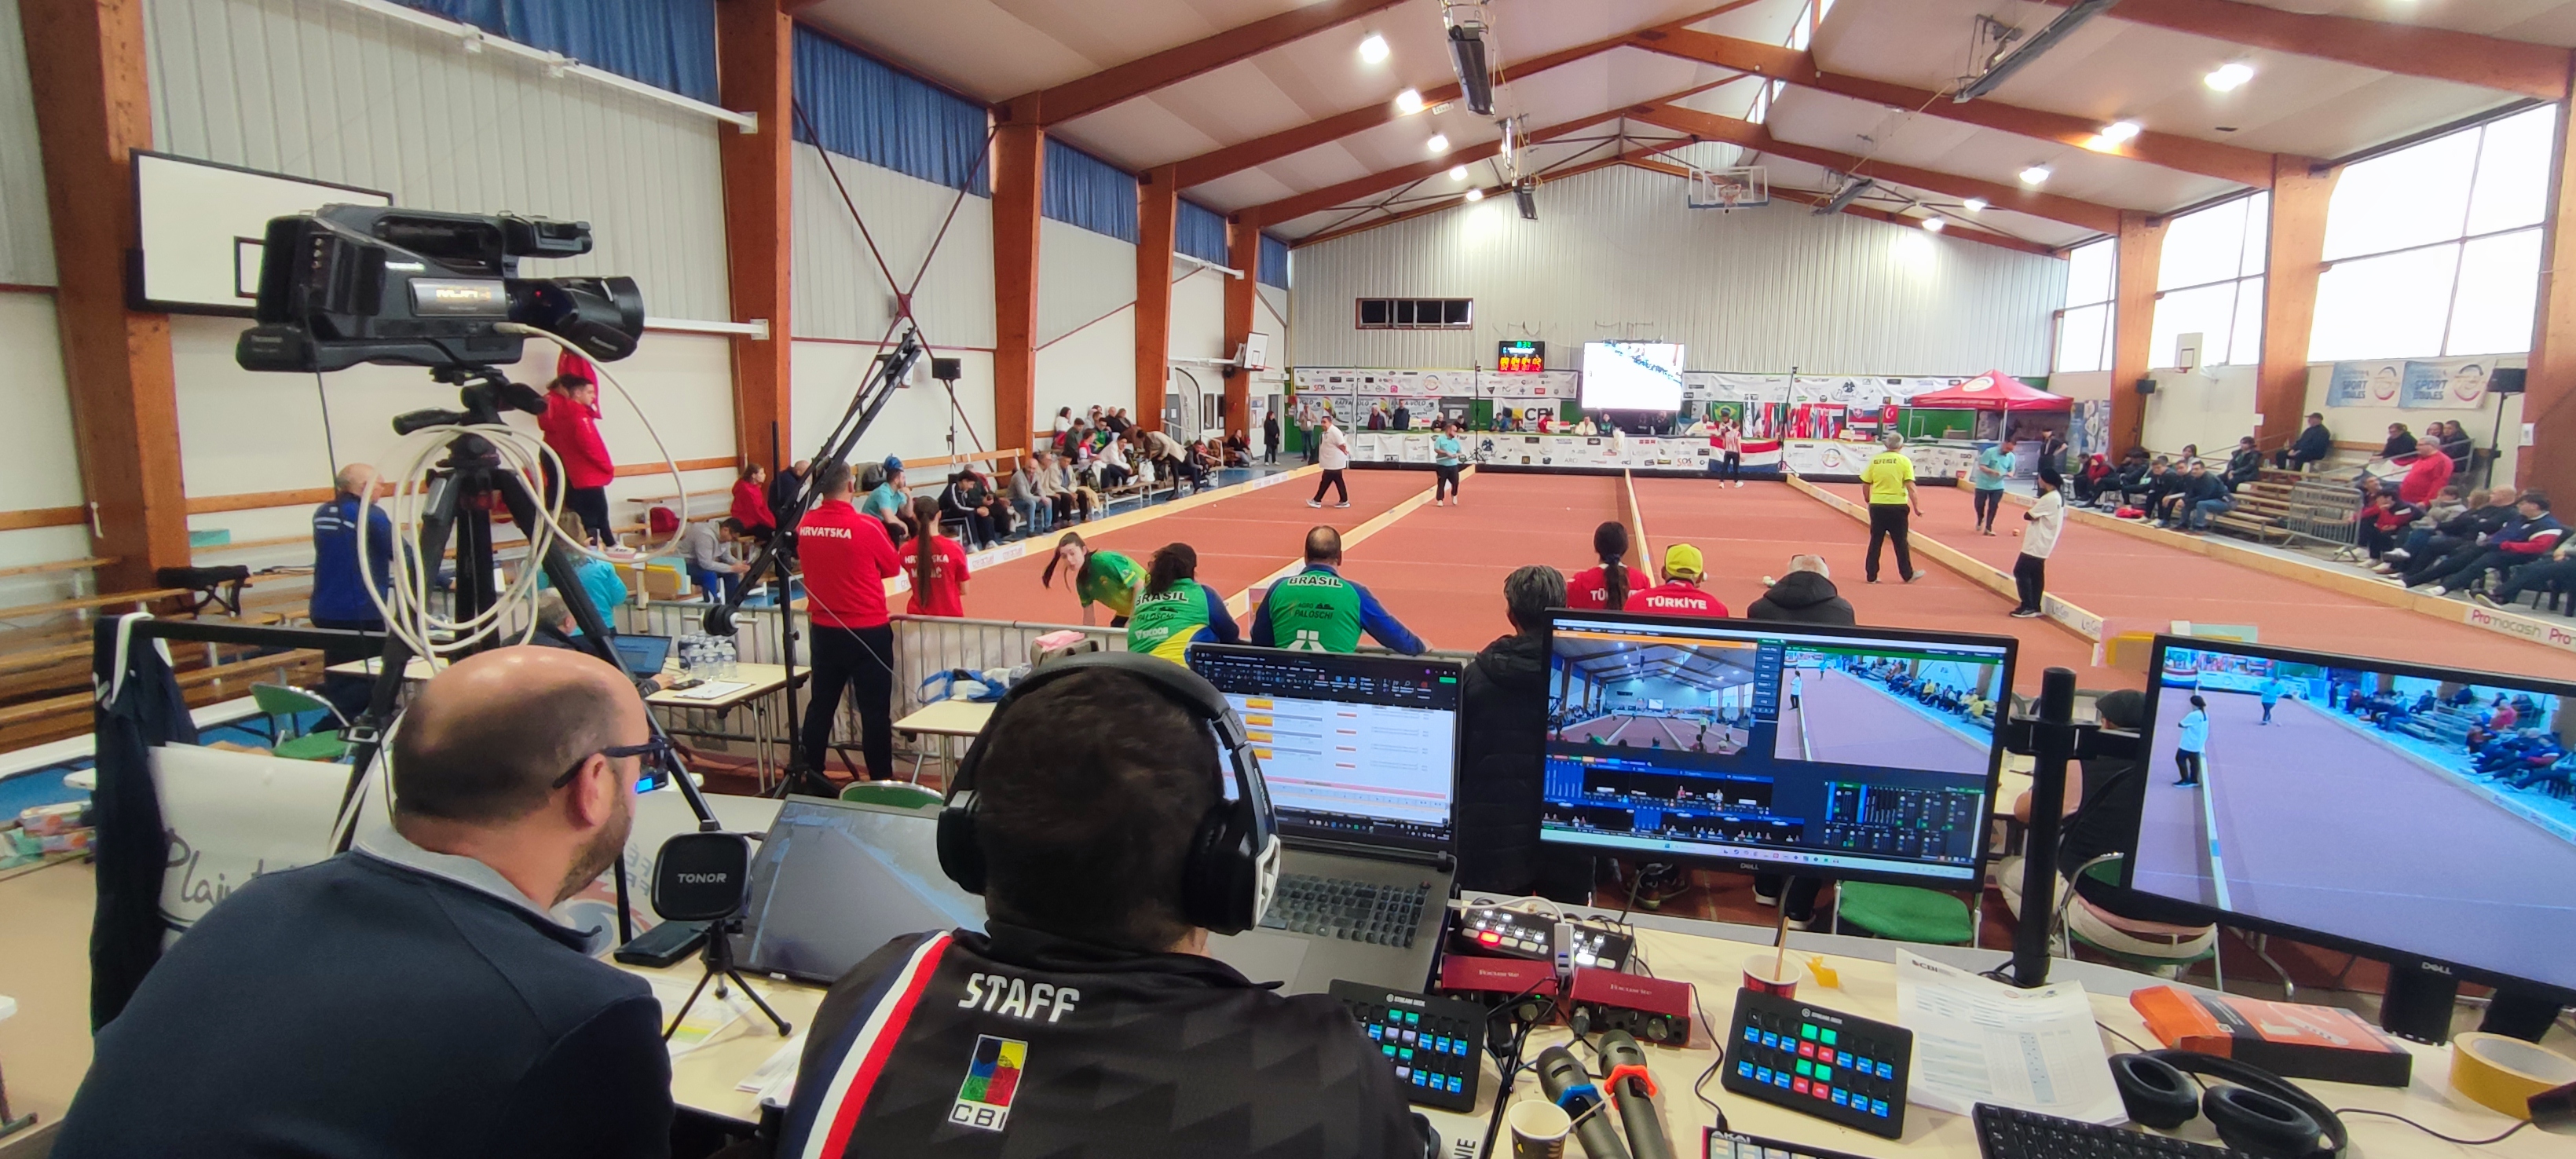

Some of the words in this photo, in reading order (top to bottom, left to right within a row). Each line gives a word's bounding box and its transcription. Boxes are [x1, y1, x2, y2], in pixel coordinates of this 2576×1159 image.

[2415, 379, 2448, 390] SPORT
[800, 526, 852, 539] HRVATSKA
[904, 554, 950, 565] HRSKA
[1288, 575, 1343, 587] BRASIL
[1646, 594, 1707, 610] TÜRKİYE
[1293, 609, 1334, 620] PALOSCHI
[1740, 862, 1759, 871] DELL
[677, 872, 727, 883] TONOR
[2421, 961, 2452, 974] DELL
[957, 973, 1080, 1022] STAFF
[951, 1103, 1006, 1129] CBI
[1711, 1130, 1751, 1144] AKAI
